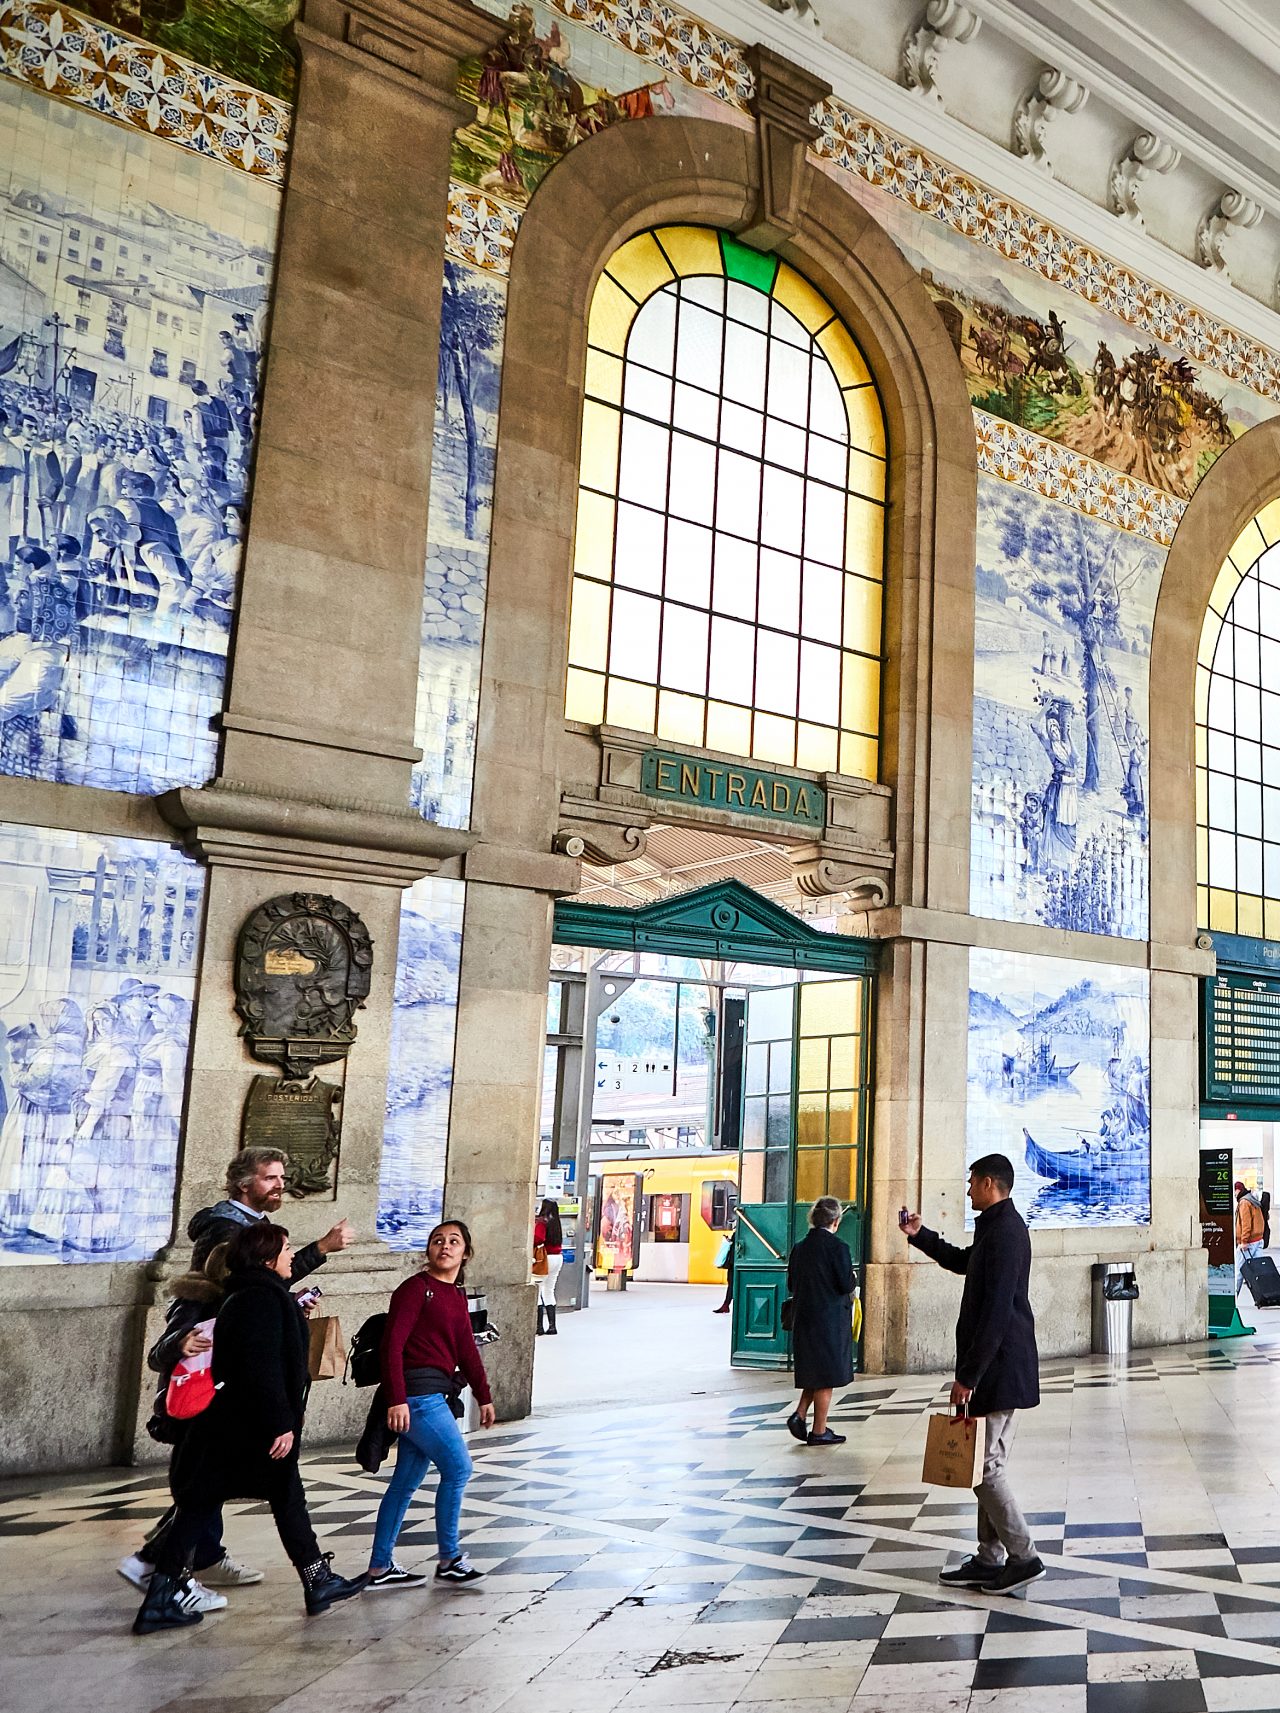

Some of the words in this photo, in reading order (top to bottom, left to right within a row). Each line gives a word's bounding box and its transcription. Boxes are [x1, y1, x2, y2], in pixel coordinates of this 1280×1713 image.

[656, 758, 812, 818] ENTRADA
[616, 1064, 621, 1072] 1
[632, 1064, 638, 1073] 2
[615, 1081, 621, 1090] 3
